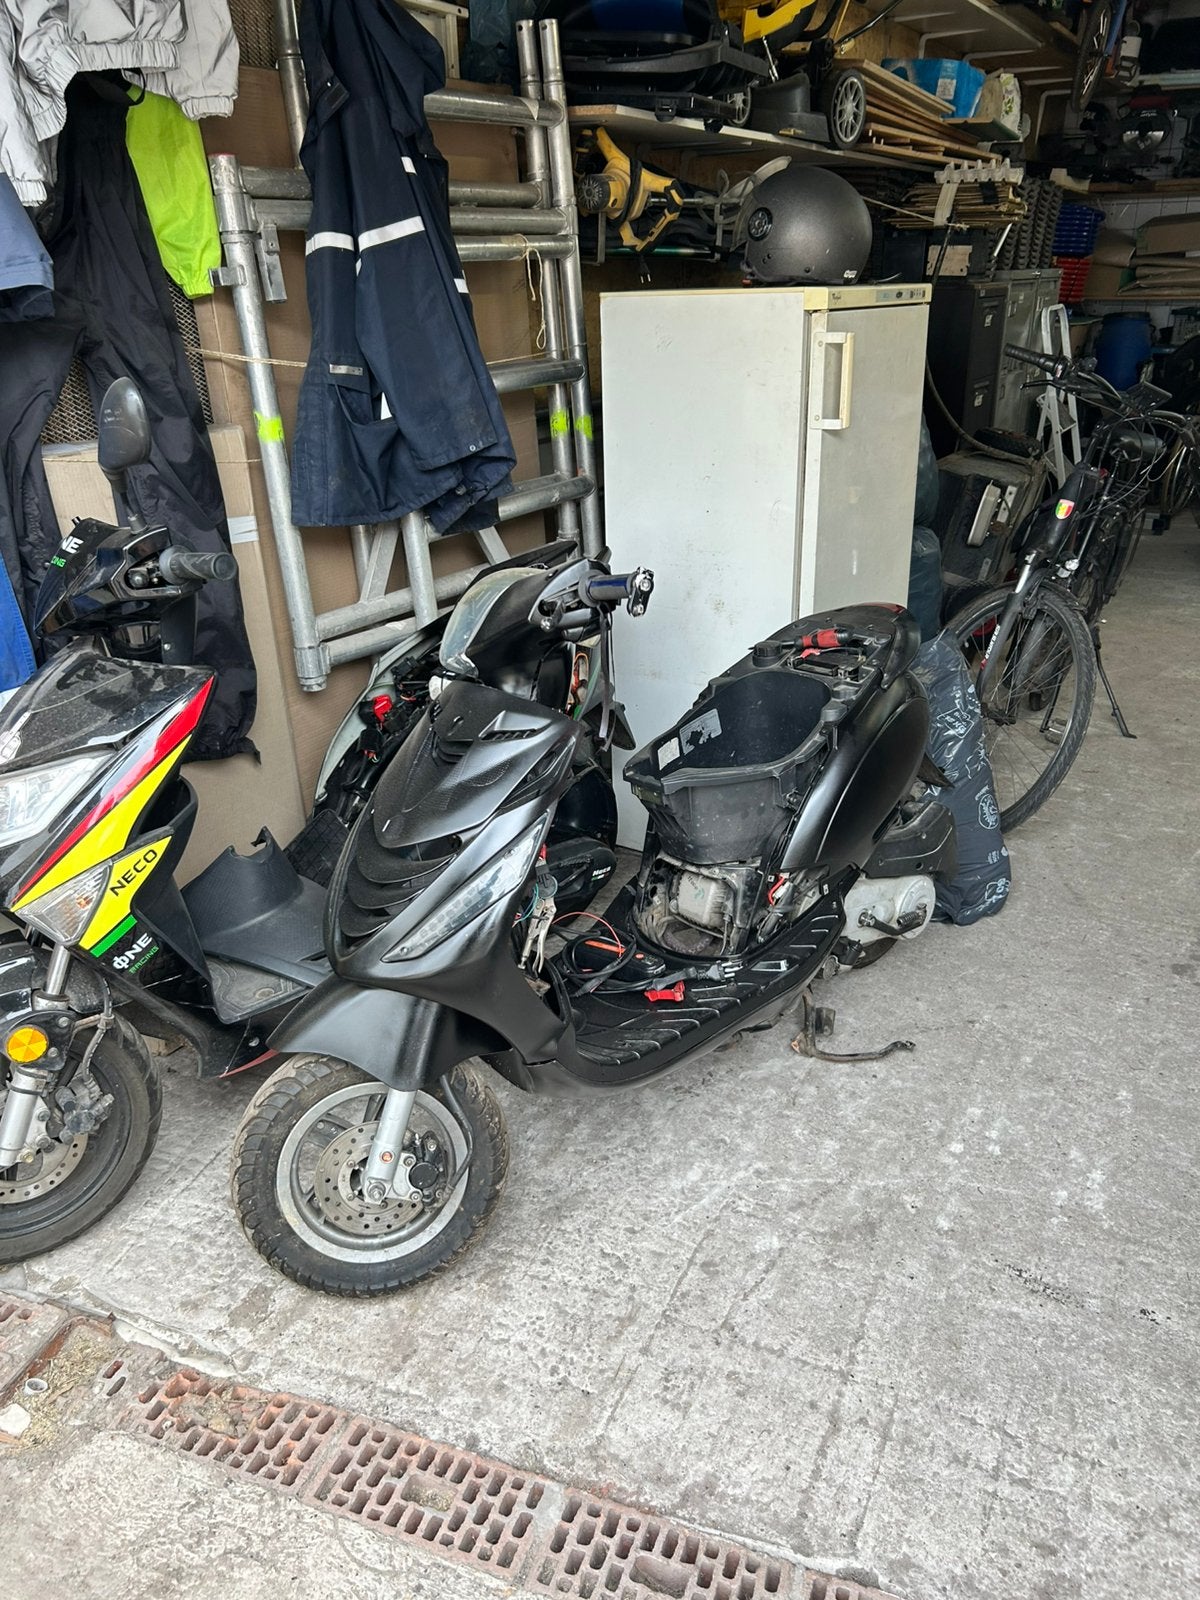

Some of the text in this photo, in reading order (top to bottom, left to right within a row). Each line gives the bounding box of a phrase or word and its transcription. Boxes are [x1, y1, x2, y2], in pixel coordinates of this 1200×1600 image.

[62, 536, 84, 554] NE
[109, 849, 158, 896] NECO
[128, 945, 160, 975] RACING
